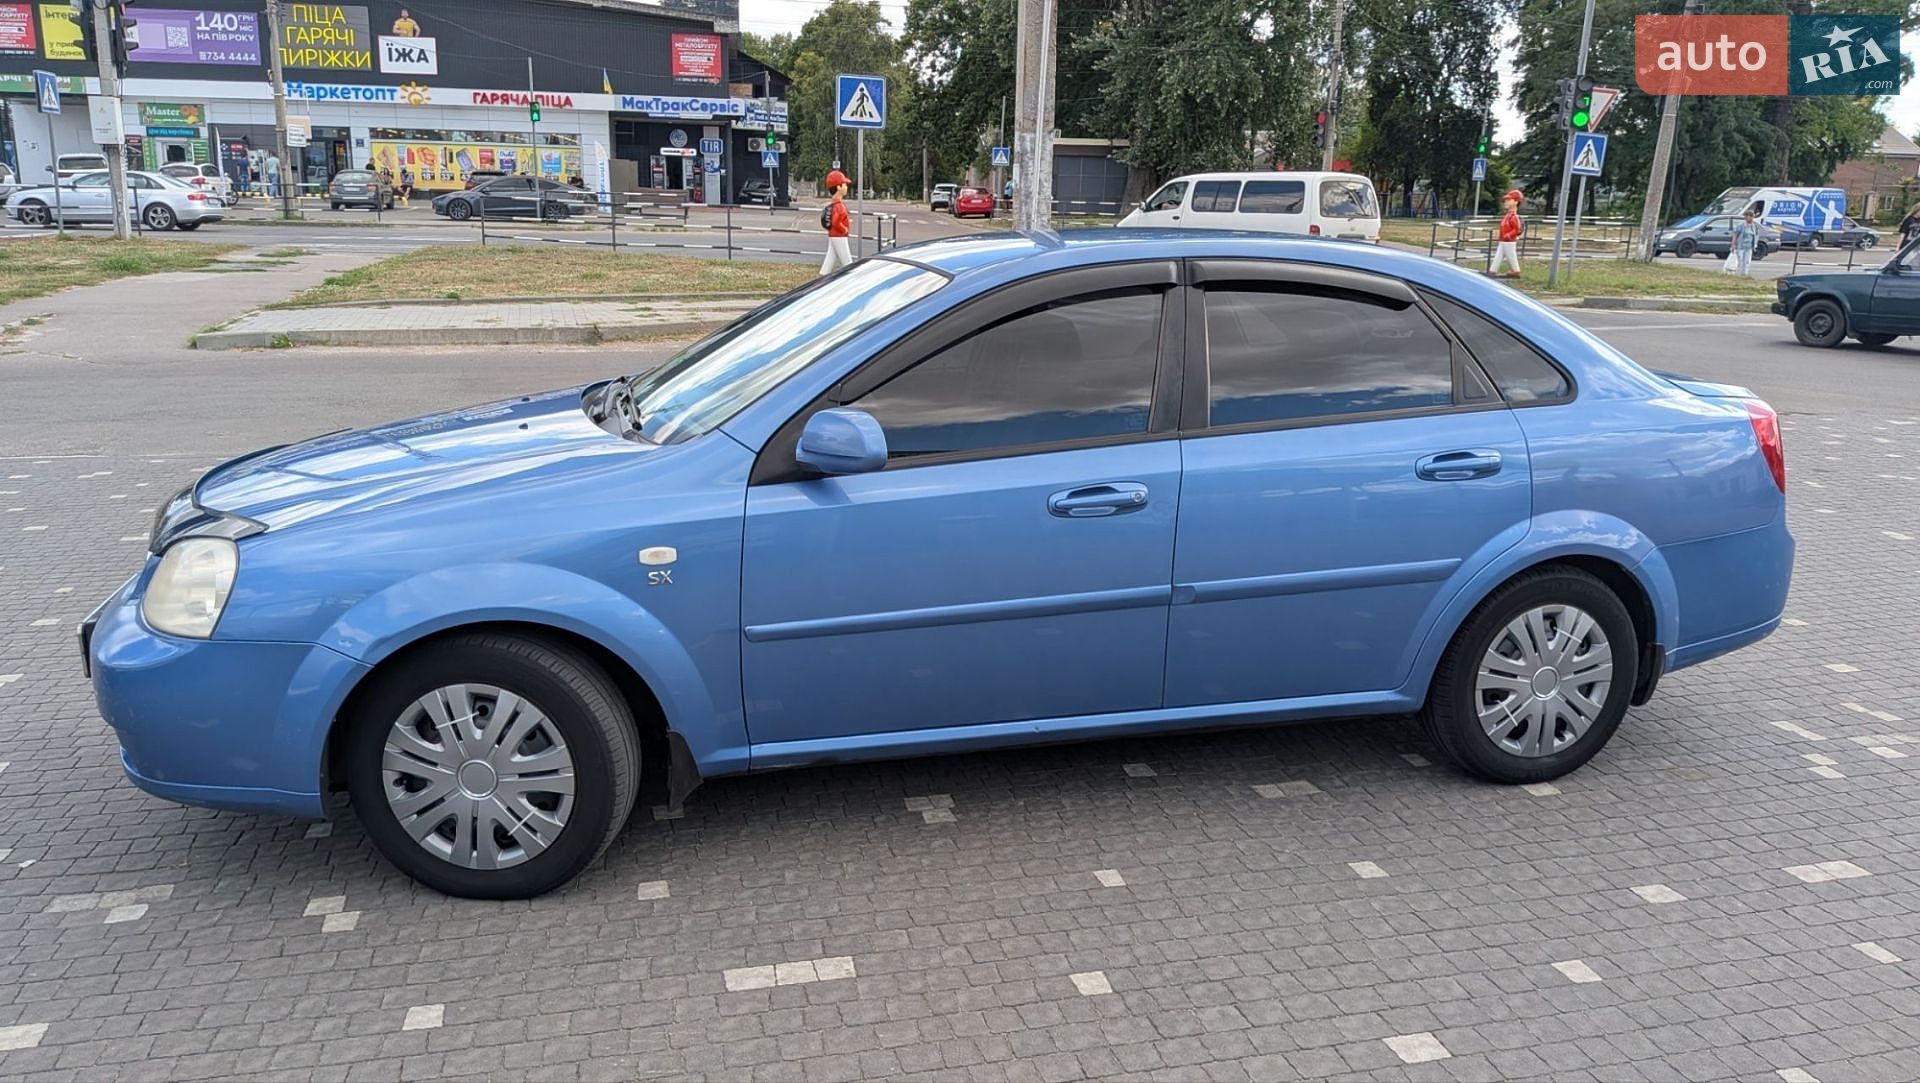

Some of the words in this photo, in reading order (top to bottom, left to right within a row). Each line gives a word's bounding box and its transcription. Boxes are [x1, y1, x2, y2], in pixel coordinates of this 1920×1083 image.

[195, 12, 238, 31] 140
[292, 4, 347, 27] ПІЦА
[286, 26, 355, 46] ГАРЯЧІ
[228, 52, 256, 61] 4444
[386, 43, 429, 64] ЇЖА
[286, 80, 398, 102] Маркетопт
[472, 92, 531, 106] ГАРЯЧА
[535, 94, 573, 109] ПІЦА
[622, 97, 739, 115] МакТракСервіс
[146, 106, 180, 116] Master
[704, 140, 720, 152] TIR
[648, 570, 673, 585] SX
